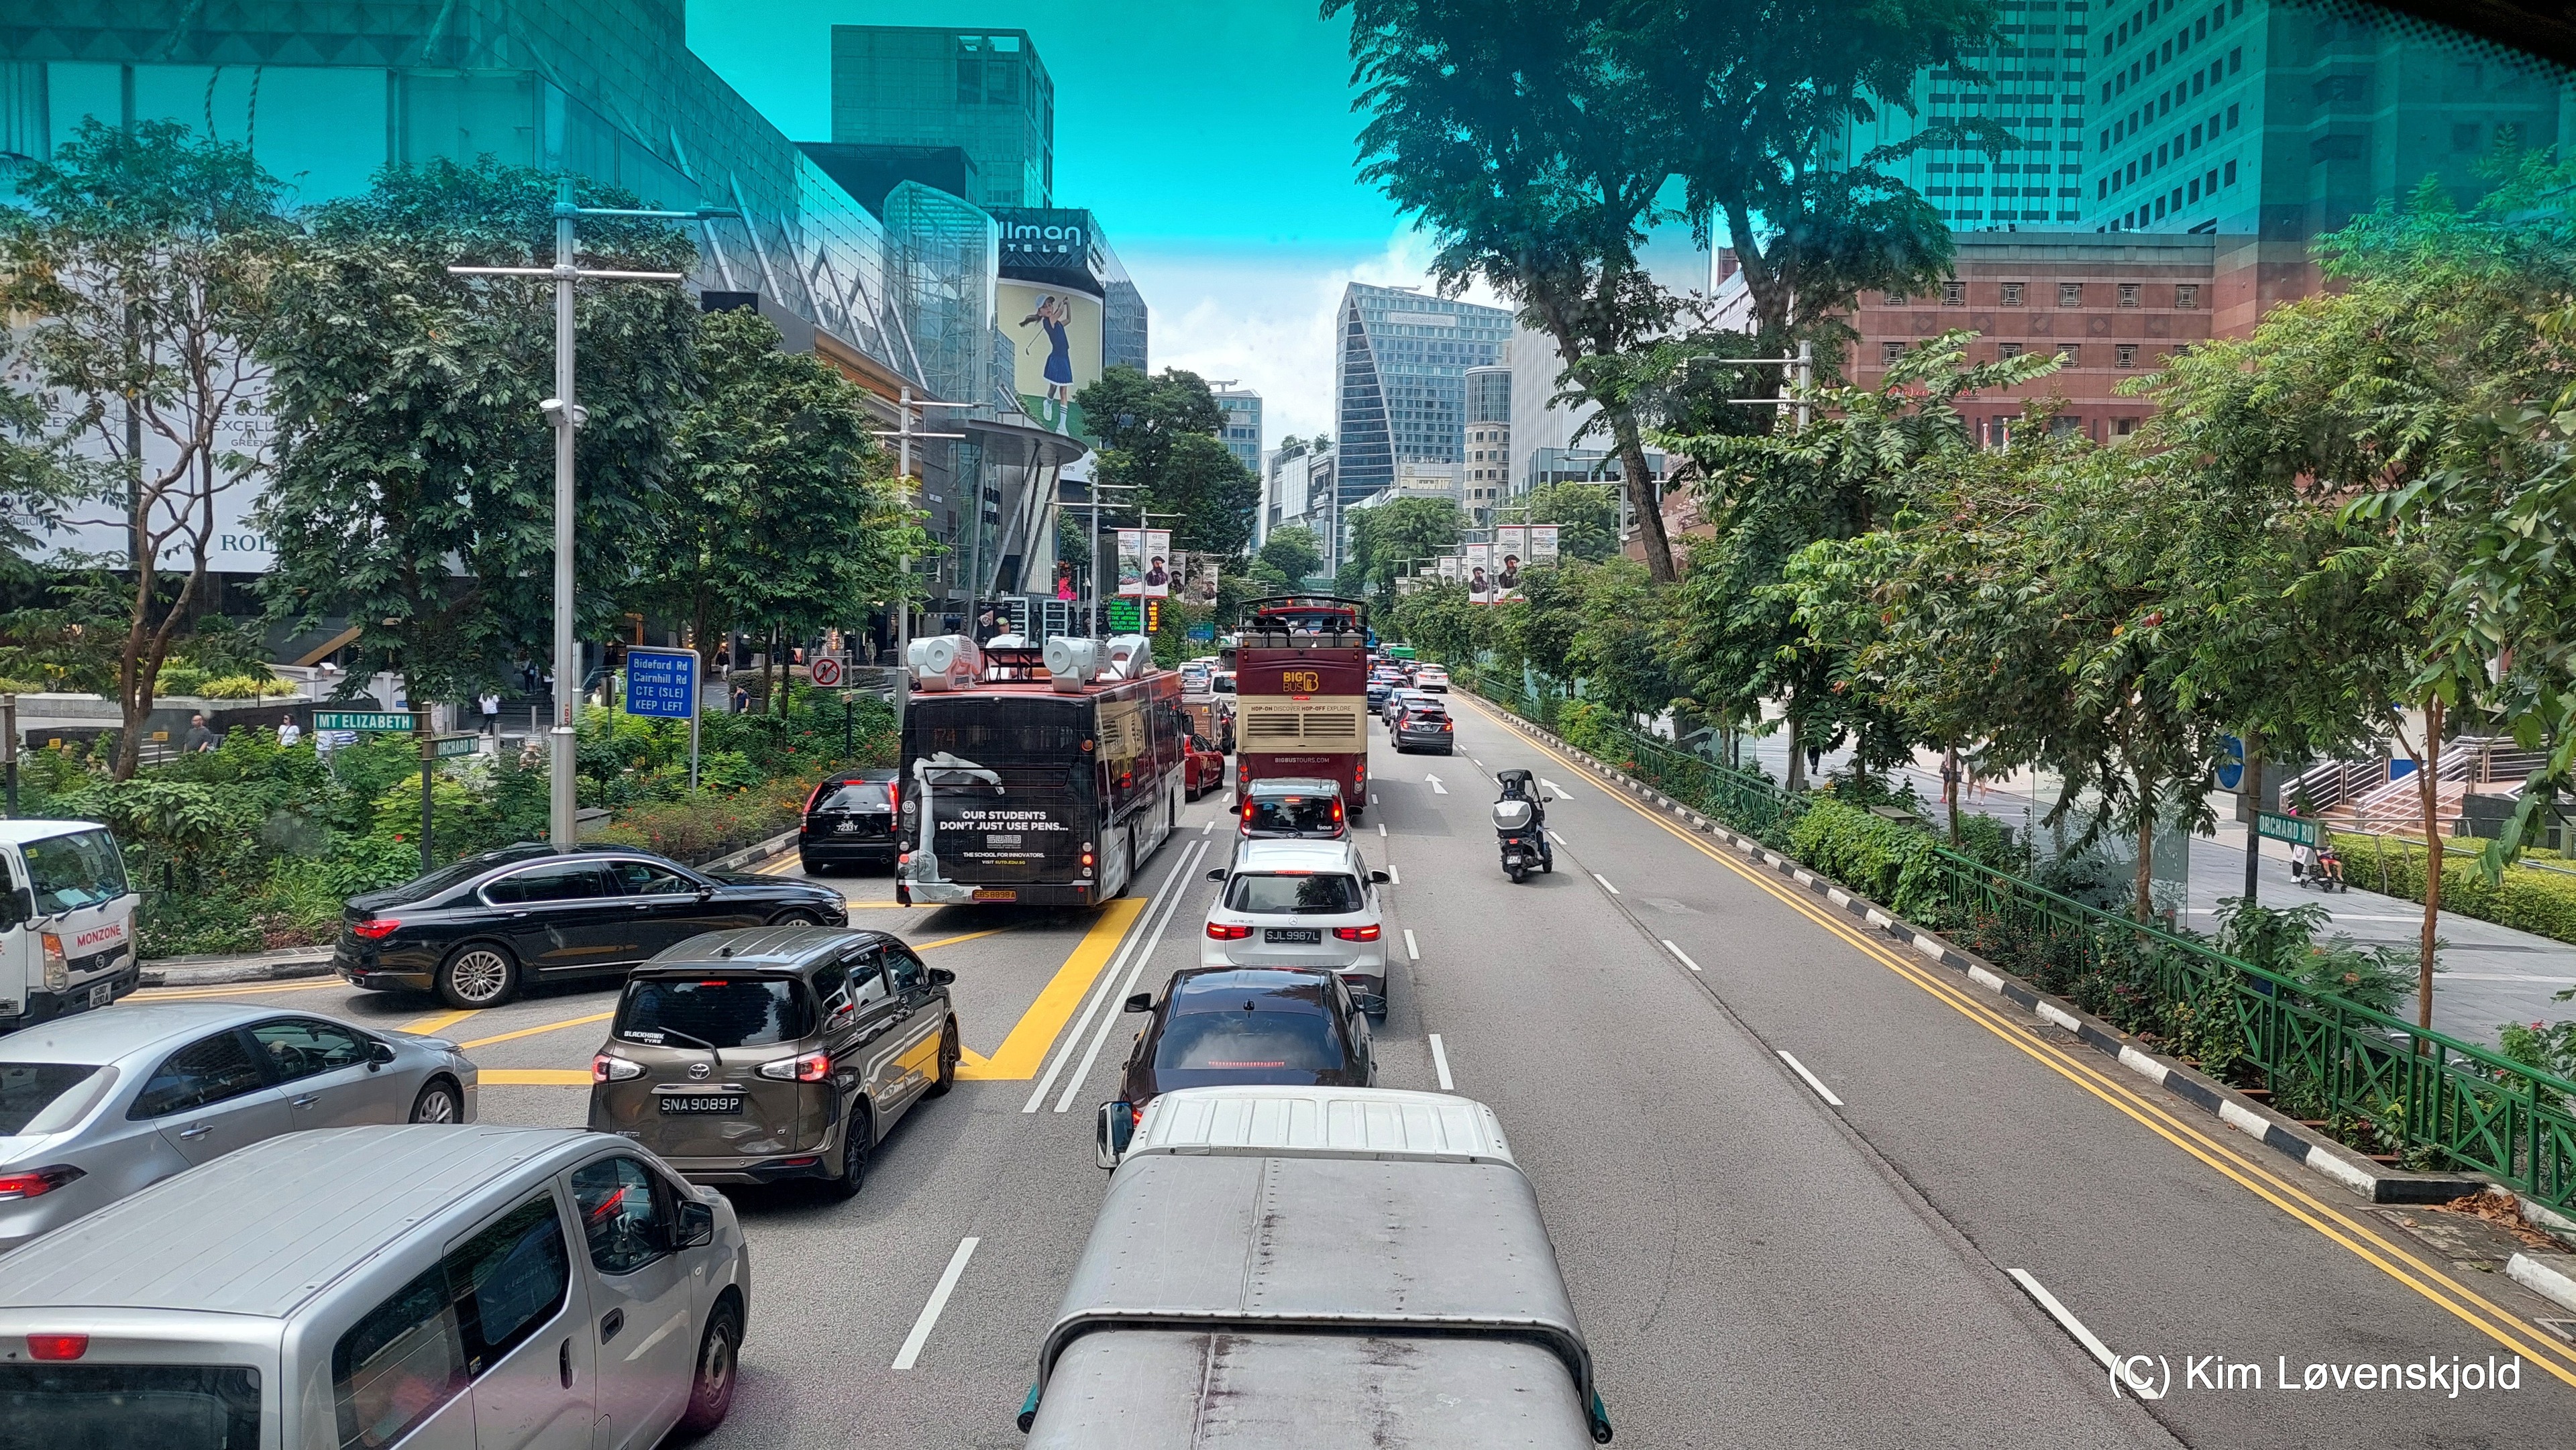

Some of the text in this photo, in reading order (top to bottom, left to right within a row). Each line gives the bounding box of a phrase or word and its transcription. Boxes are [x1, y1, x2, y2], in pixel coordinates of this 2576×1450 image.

[1000, 222, 1080, 246] llman
[1008, 244, 1067, 253] TELS
[634, 659, 688, 671] Bideford Rd
[634, 672, 687, 685] Cairnhill Rd
[1283, 672, 1303, 682] BIG
[636, 686, 684, 698] CTE (SLE)
[1283, 683, 1303, 691] BUS
[636, 700, 682, 712] KEEP LEFT
[319, 714, 410, 728] MT ELIZABETH
[438, 738, 478, 755] ORCHARD RD
[962, 811, 1046, 820] OUR STUDENTS
[977, 822, 1004, 830] JUST
[1007, 822, 1028, 830] USE
[2259, 815, 2314, 843] ORCHARD RD
[77, 924, 121, 947] MONZONE
[624, 1031, 665, 1040] BLACKHAWK
